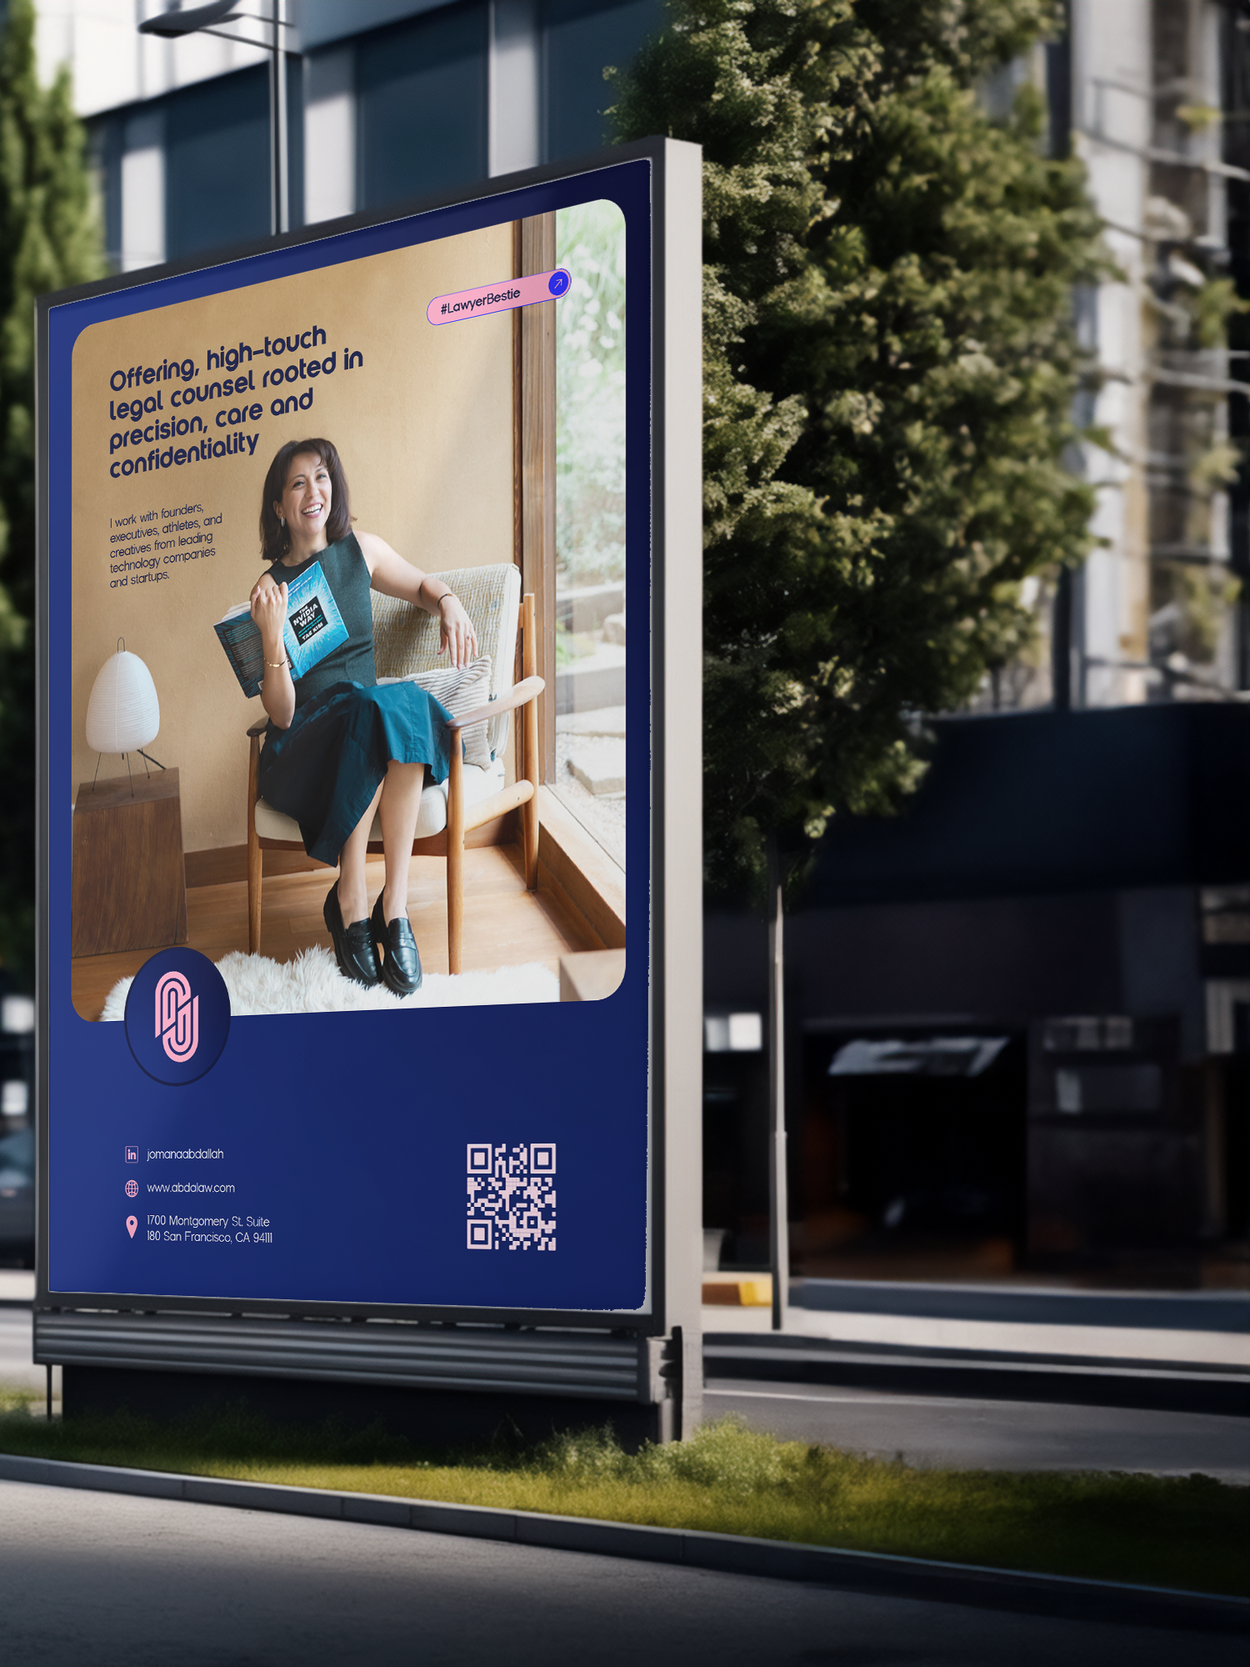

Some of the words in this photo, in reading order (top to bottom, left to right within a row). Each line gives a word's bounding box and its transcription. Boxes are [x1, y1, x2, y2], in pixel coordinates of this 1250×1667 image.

[441, 288, 521, 315] #LawyerBestie
[110, 359, 200, 392] Offering,
[207, 325, 326, 372] high-touch
[109, 390, 163, 422] legal
[171, 370, 255, 408] counsel
[263, 352, 337, 388] rooted
[344, 348, 363, 370] in
[109, 416, 208, 455] precision,
[216, 403, 263, 428] care
[270, 387, 313, 416] and
[110, 432, 259, 479] confidentiality
[110, 518, 113, 528] I
[115, 514, 137, 527] work
[140, 511, 158, 522] with
[161, 504, 204, 519] founders,
[110, 527, 160, 543] executives,
[162, 520, 201, 534] athletes,
[203, 512, 222, 526] and
[110, 544, 151, 558] creatives
[154, 540, 175, 550] from
[178, 532, 213, 546] leading
[110, 557, 161, 573] technology
[163, 547, 216, 563] companies
[110, 576, 128, 588] and
[131, 572, 169, 584] startups.
[293, 604, 319, 626] NVIDIA
[300, 612, 315, 627] WAY
[128, 1149, 137, 1160] in
[147, 1149, 224, 1162] jomanaabdallah
[147, 1183, 236, 1193] www.abdalaw.com
[147, 1215, 166, 1226] 1700
[169, 1215, 229, 1229] Montgomery
[232, 1216, 243, 1227] St.
[246, 1216, 270, 1227] Suite
[147, 1231, 161, 1241] 180
[164, 1231, 182, 1242] San
[185, 1231, 233, 1244] Francisco,
[235, 1232, 251, 1243] CA
[253, 1233, 273, 1243] 94111
